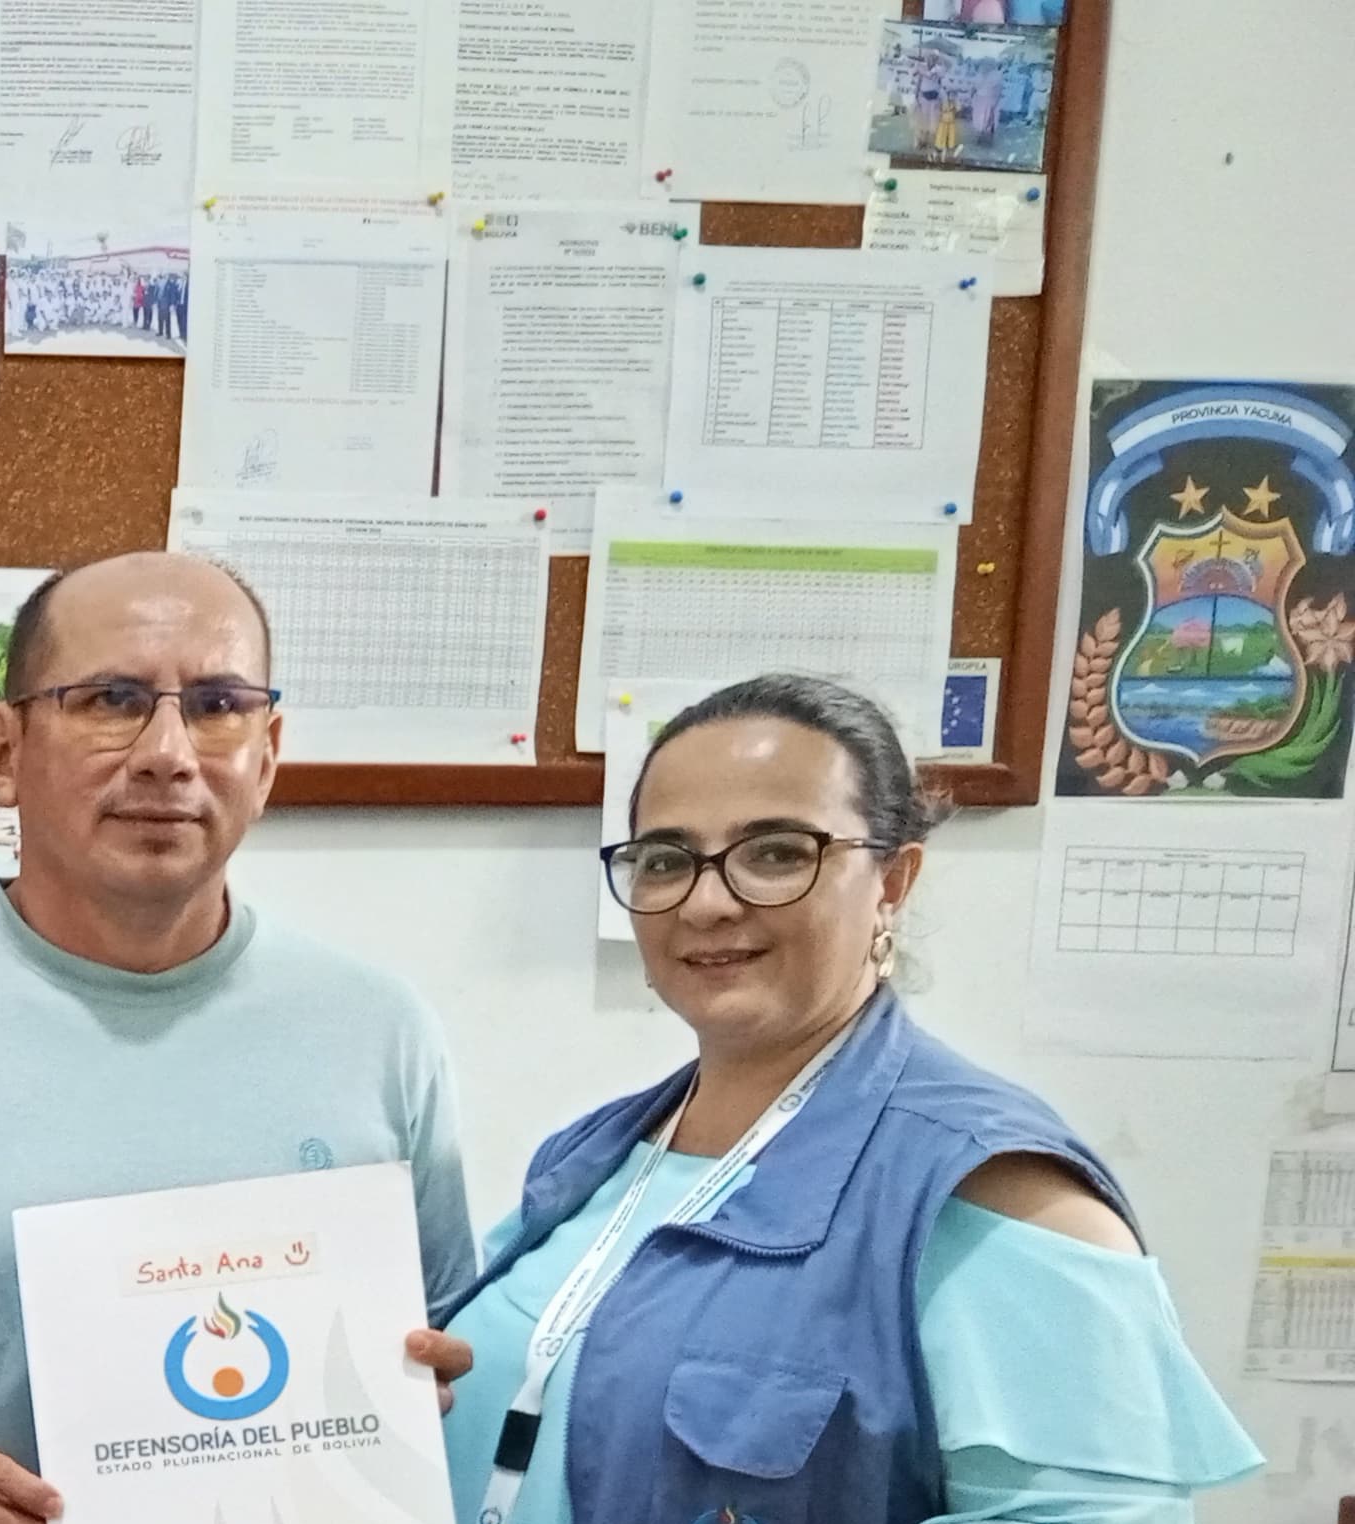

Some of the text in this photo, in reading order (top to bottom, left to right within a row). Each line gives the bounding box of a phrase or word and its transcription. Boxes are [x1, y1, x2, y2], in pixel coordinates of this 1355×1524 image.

[1172, 404, 1292, 426] PROVINCIA YACUMA
[948, 661, 987, 670] UROPEA
[137, 1252, 263, 1284] Santa Ana
[94, 1414, 380, 1462] DEFENSORÍA DEL PUEBLO
[97, 1436, 382, 1475] ESTADO PLURINACIONAL DE BOLIVIA
